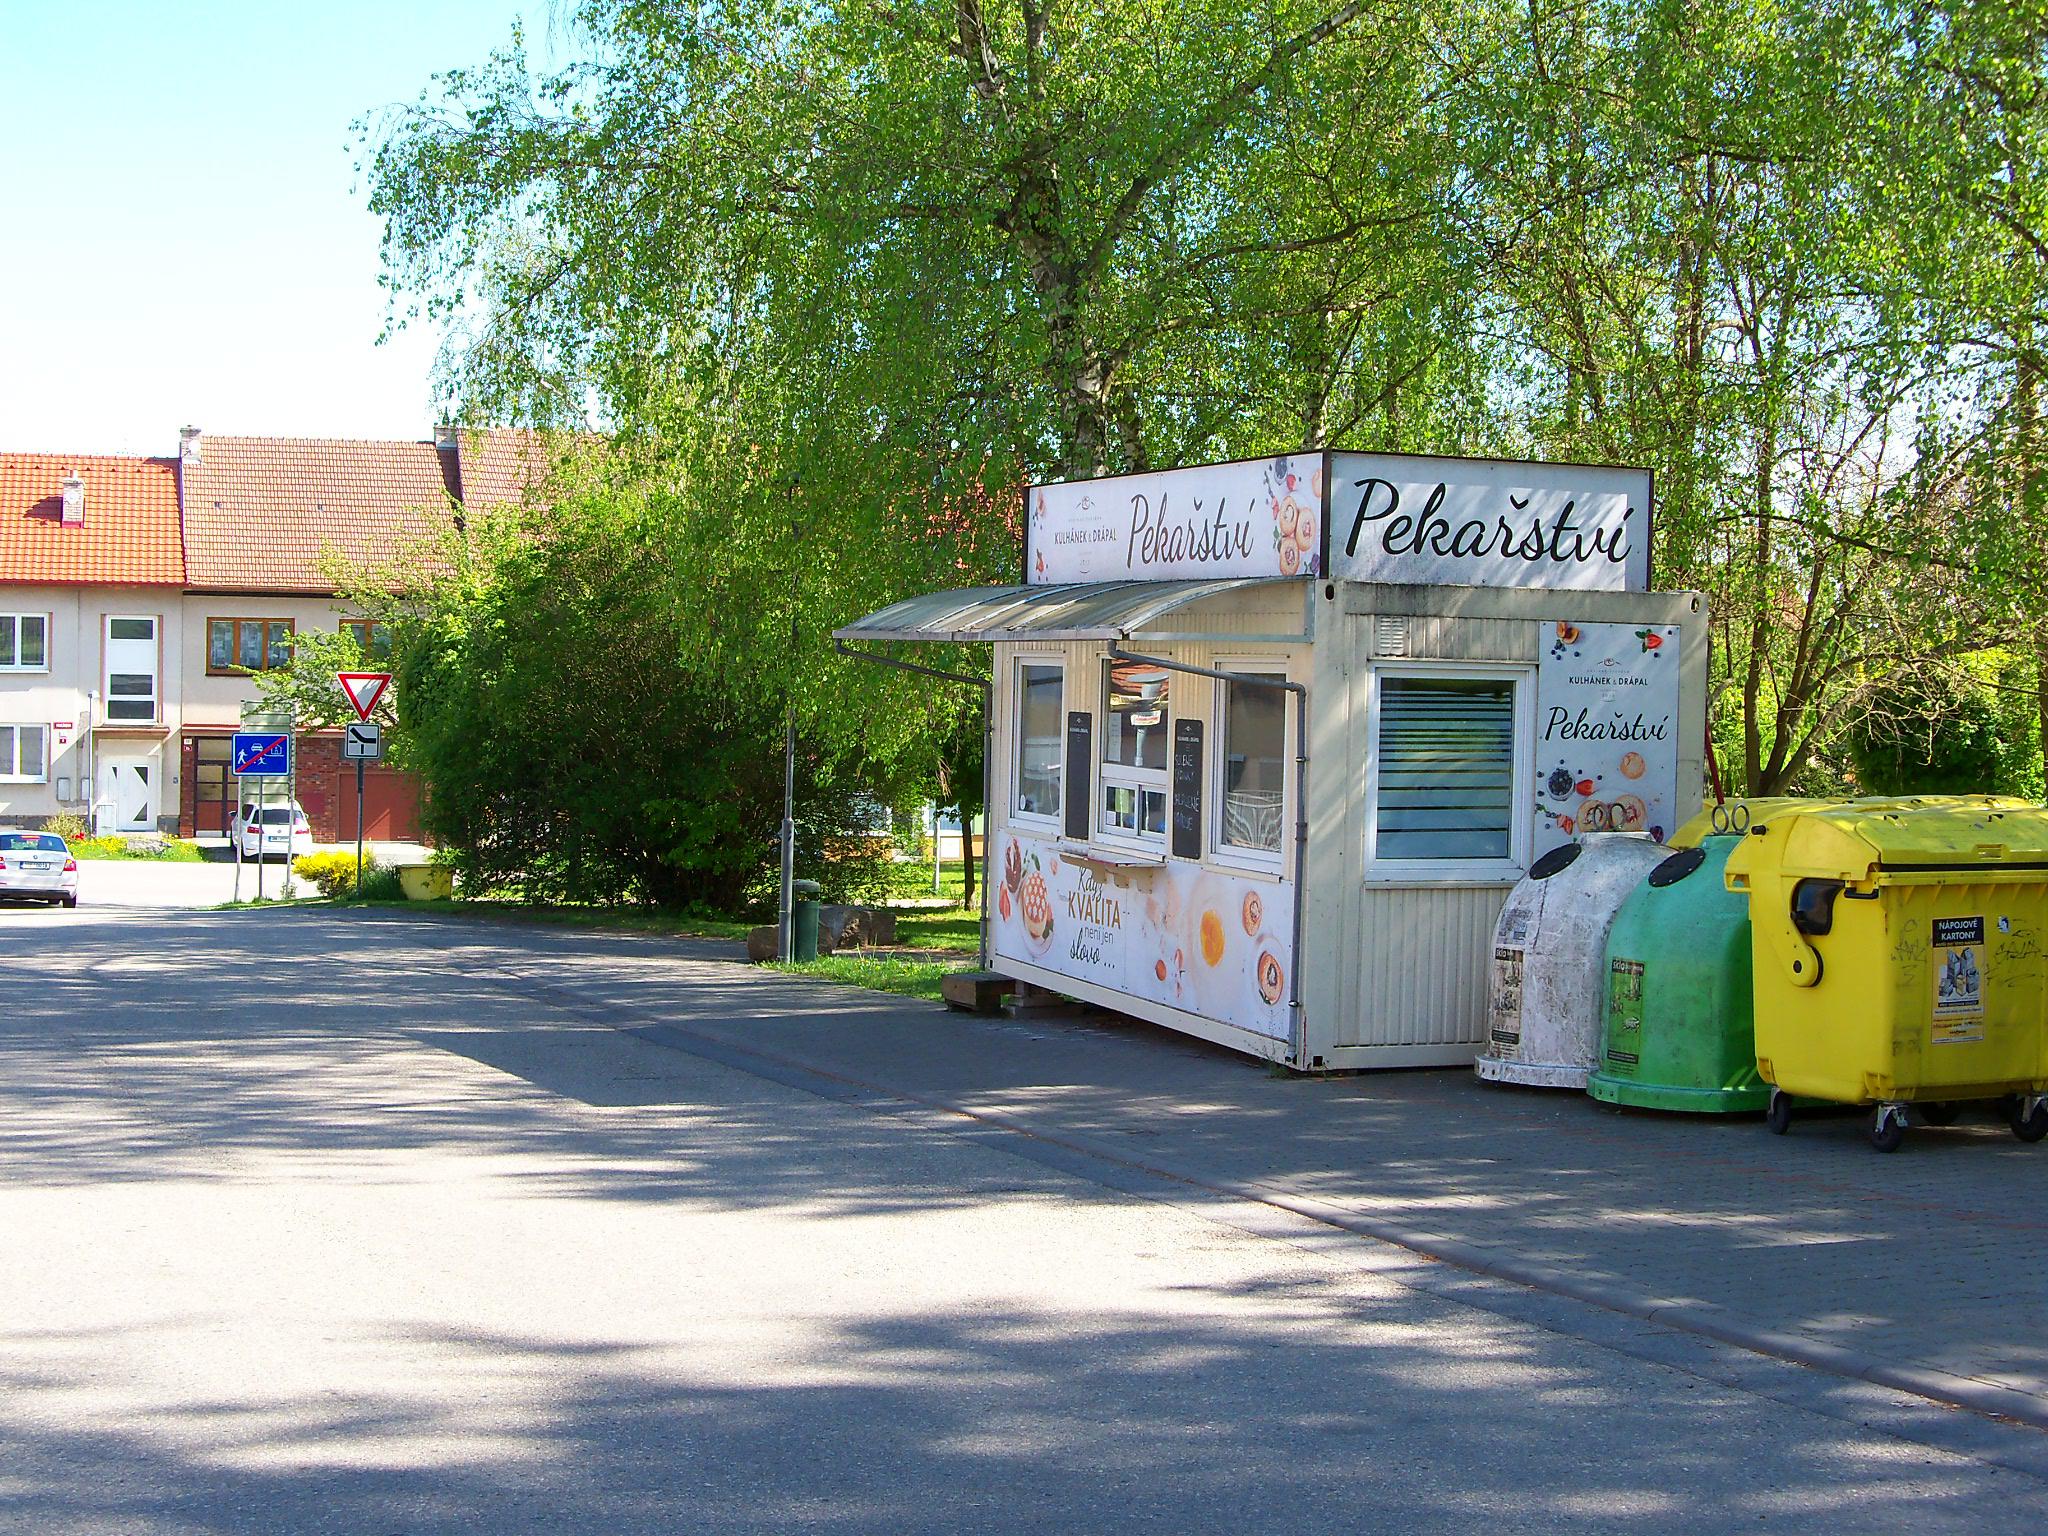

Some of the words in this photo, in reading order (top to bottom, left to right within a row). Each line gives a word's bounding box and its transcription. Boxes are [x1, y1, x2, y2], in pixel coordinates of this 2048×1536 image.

[1127, 491, 1256, 569] Pekařství
[1345, 478, 1634, 562] Pekařství
[1054, 527, 1087, 545] KULHÁNEK
[1092, 525, 1117, 543] DRÁPAL
[1569, 675, 1611, 685] KULHÁNEK
[1618, 675, 1648, 686] DRÁPAL
[1545, 706, 1669, 741] Pekařství
[1068, 890, 1121, 930] KVALITA
[1938, 919, 1978, 930] NÁPOJOVÉ
[1101, 927, 1114, 945] jen
[1941, 931, 1976, 940] KARTONY
